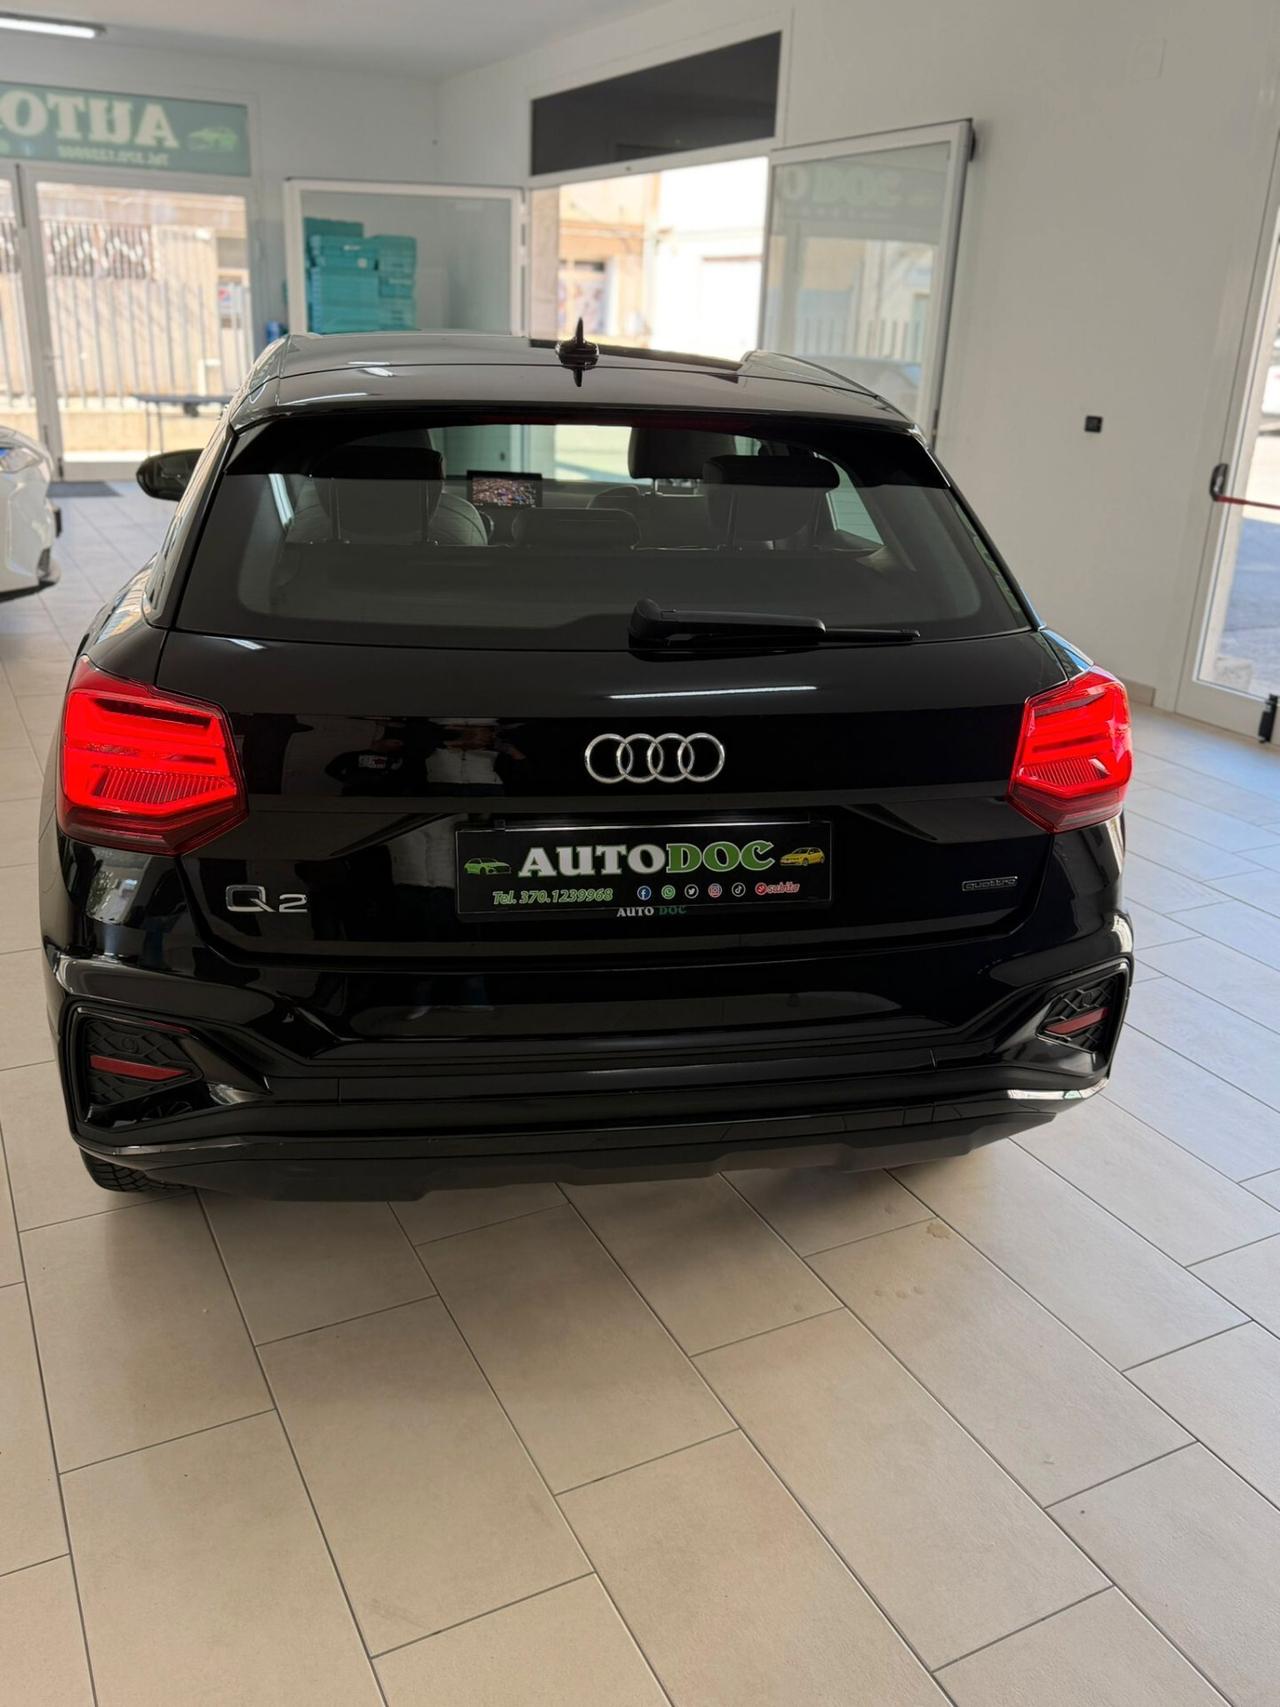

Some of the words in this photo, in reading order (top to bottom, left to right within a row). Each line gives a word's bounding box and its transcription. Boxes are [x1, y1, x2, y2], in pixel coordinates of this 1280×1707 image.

[492, 890, 517, 905] Tel.
[519, 888, 614, 904] 370.1239968
[616, 906, 655, 918] AUTO
[658, 905, 688, 916] DOC
